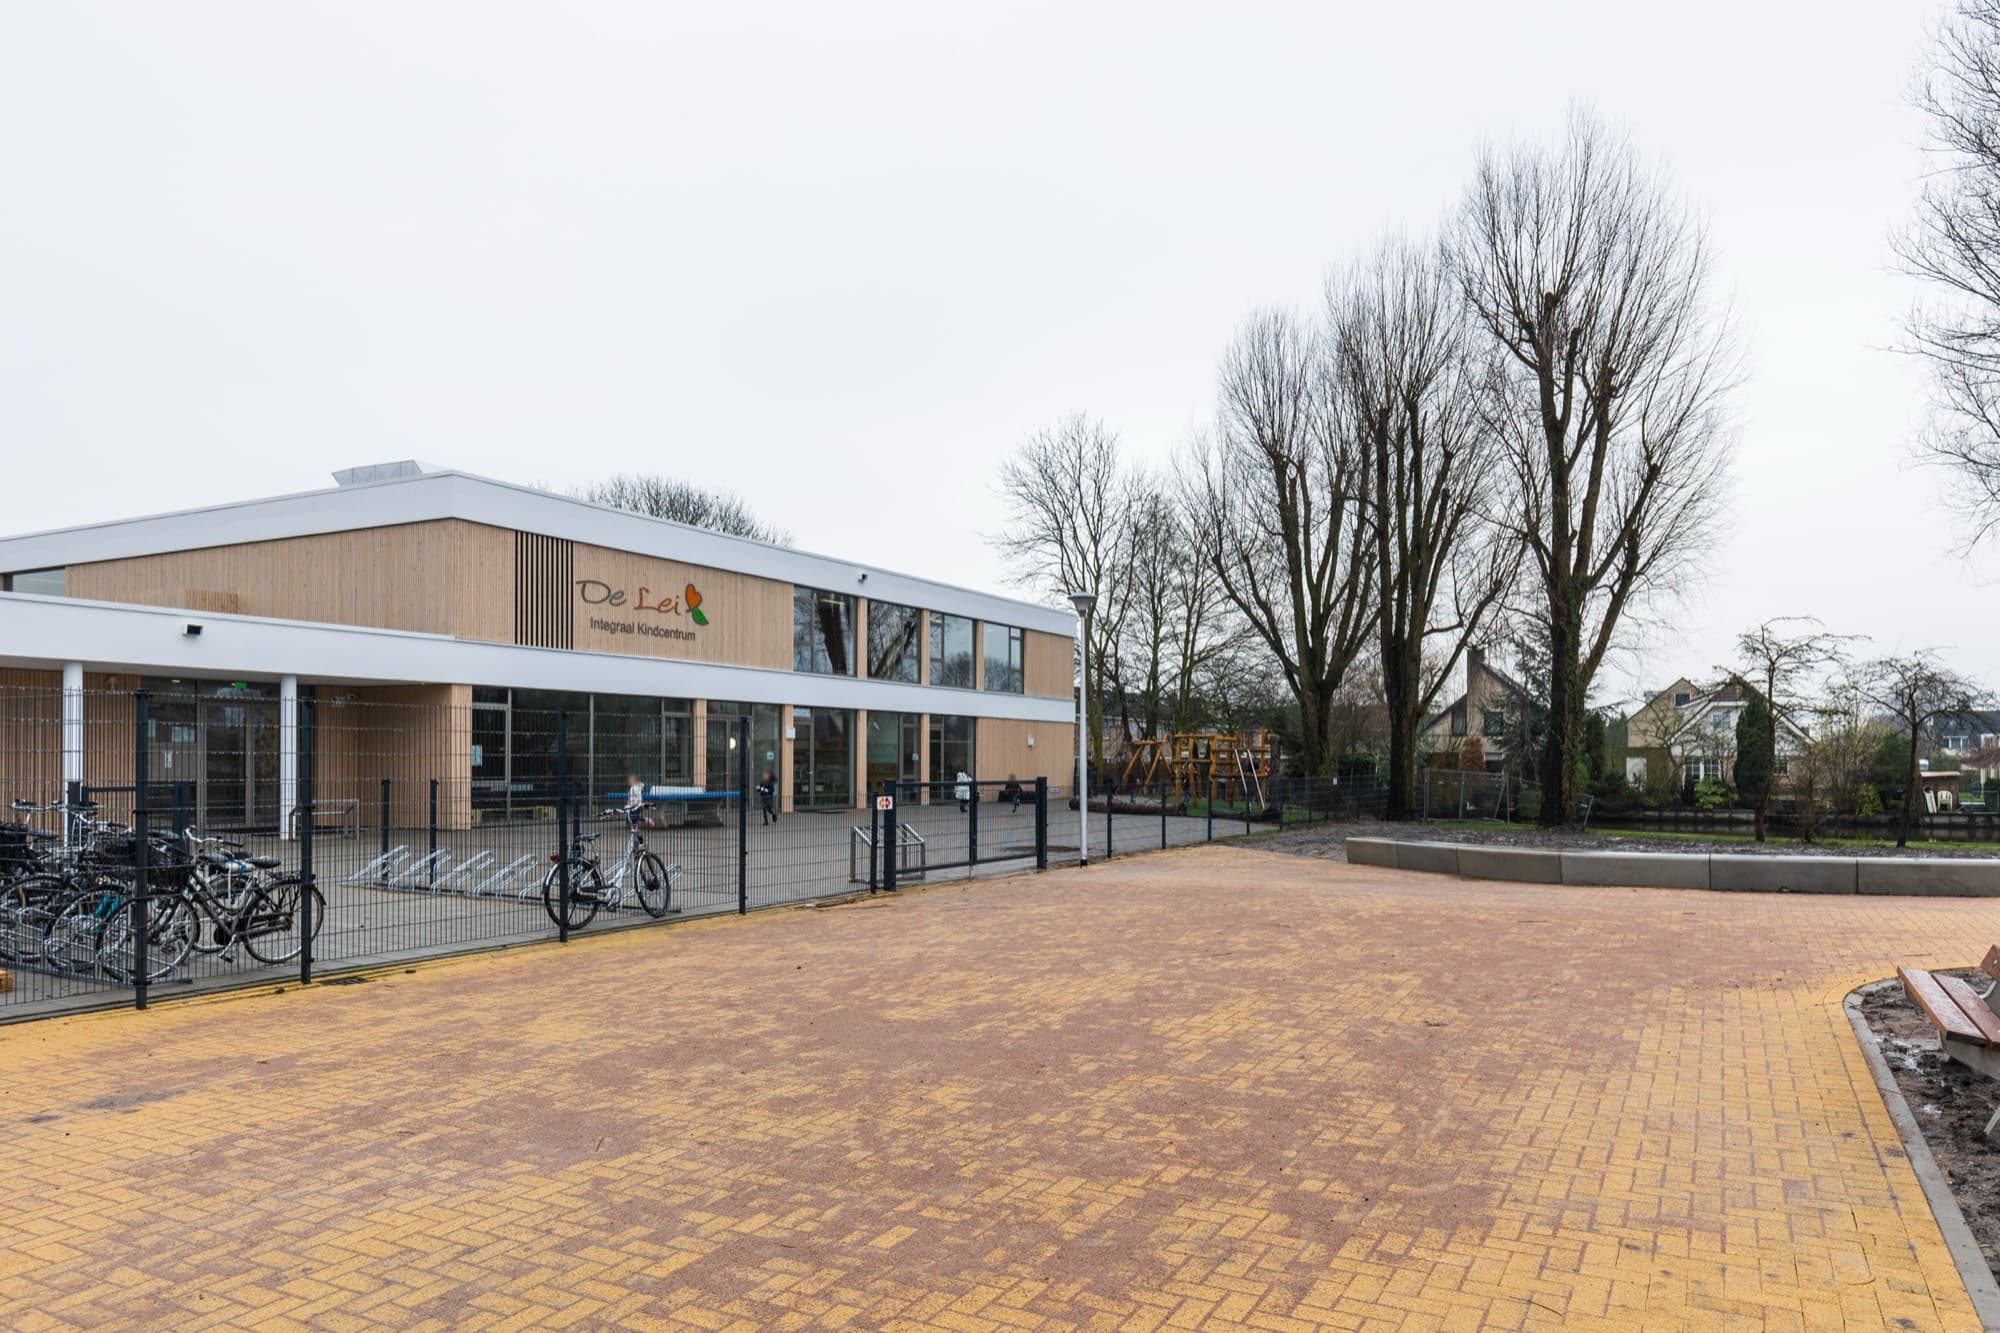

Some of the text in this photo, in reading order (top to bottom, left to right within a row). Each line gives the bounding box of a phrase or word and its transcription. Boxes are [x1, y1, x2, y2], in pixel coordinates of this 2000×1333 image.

[576, 580, 681, 616] De Lei
[590, 617, 696, 641] Integraal Kindcentrum
